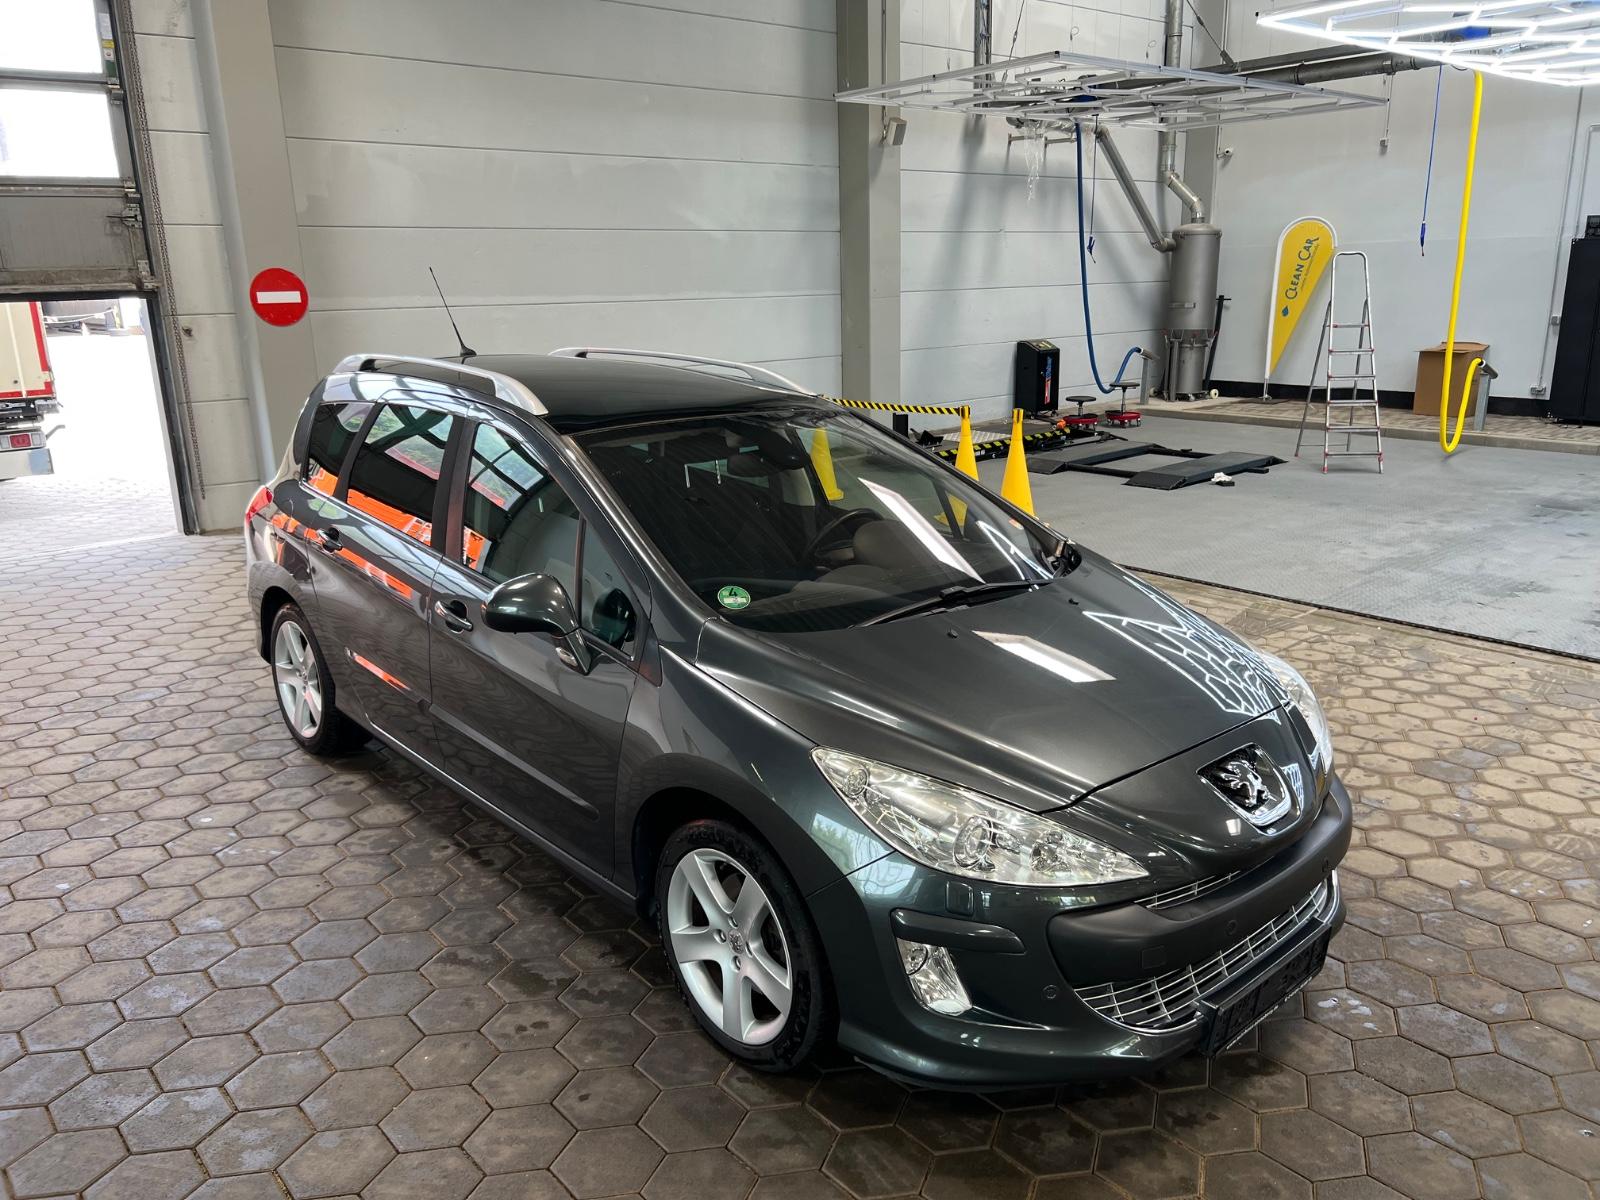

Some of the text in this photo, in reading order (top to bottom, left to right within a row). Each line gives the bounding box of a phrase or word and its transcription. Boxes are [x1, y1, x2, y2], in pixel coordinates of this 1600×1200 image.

[1285, 263, 1305, 300] CLEAN
[1298, 236, 1320, 261] CAR
[728, 587, 738, 597] 4
